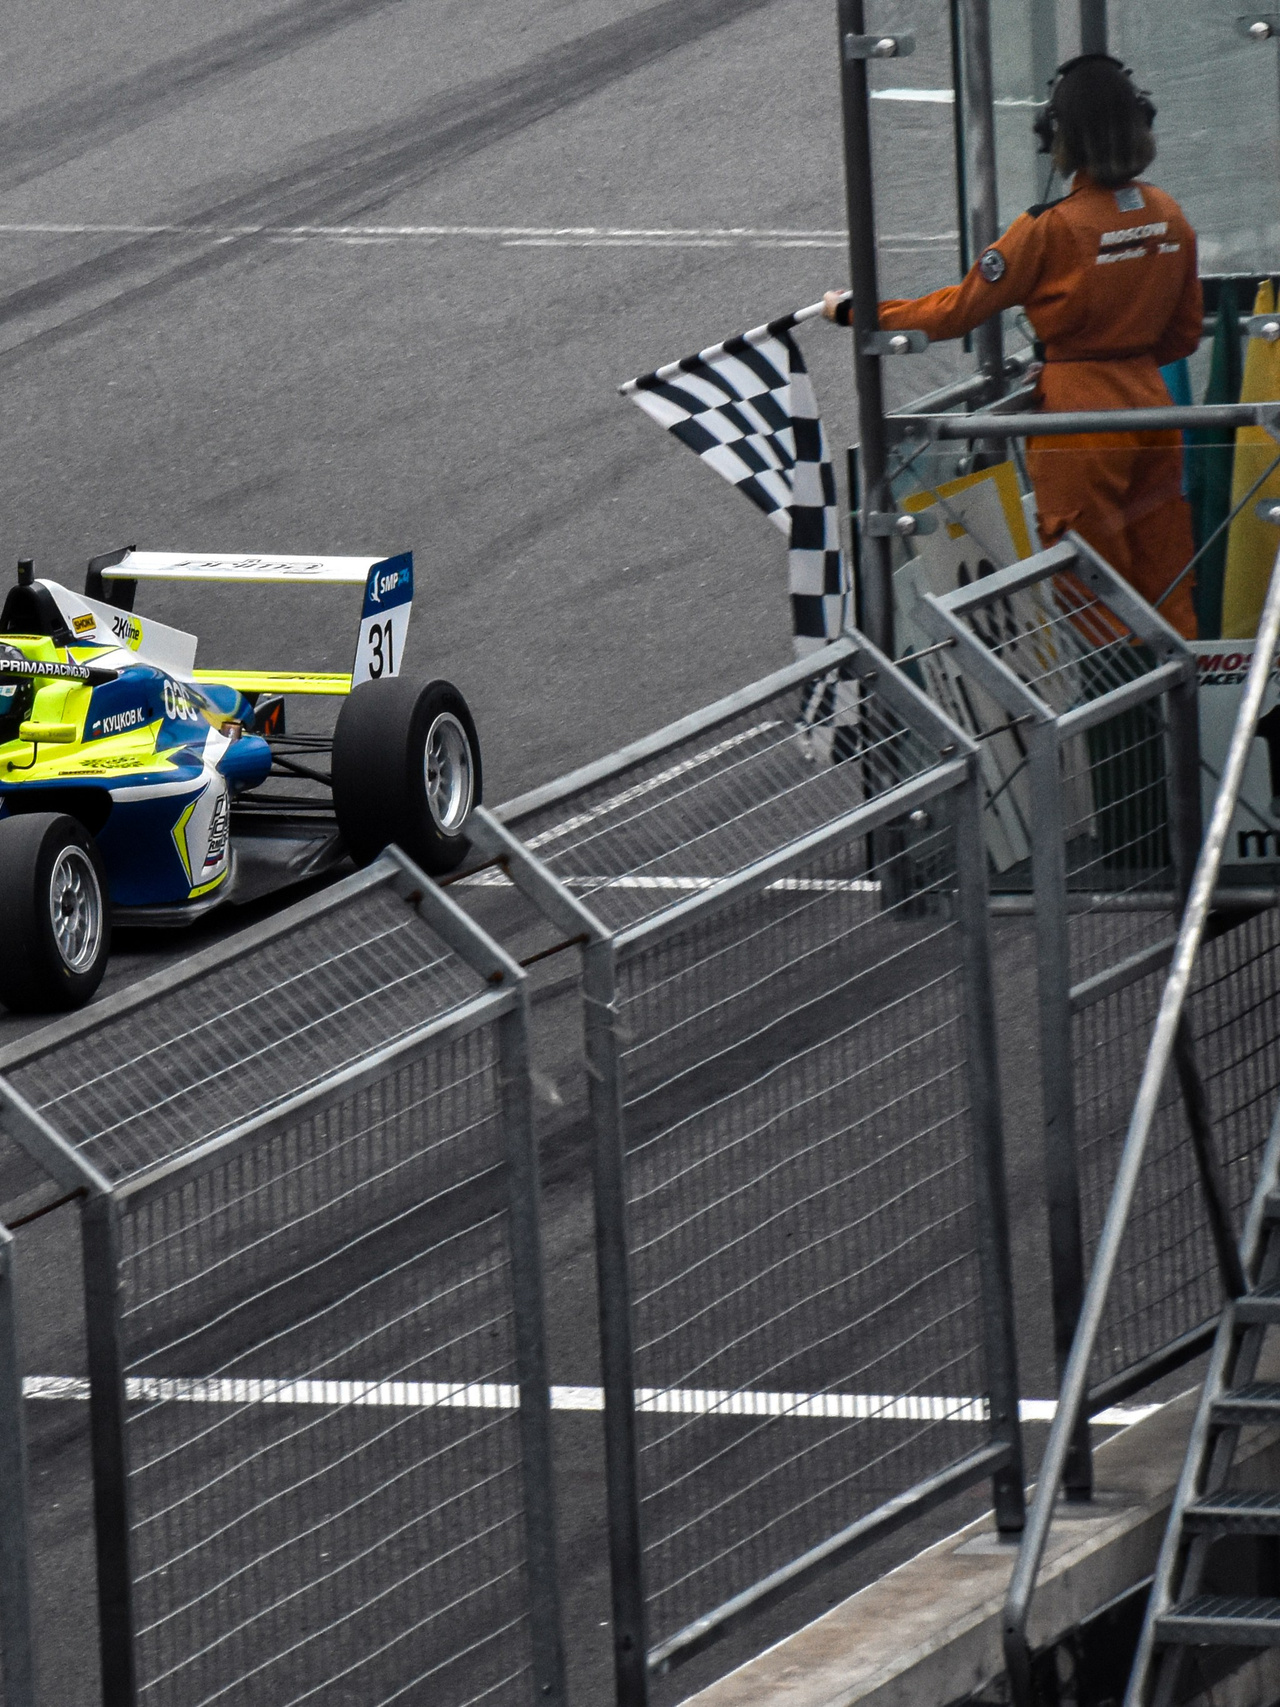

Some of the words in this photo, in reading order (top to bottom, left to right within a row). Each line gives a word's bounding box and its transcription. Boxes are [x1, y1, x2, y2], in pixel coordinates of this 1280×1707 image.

[368, 619, 393, 679] 31
[0, 659, 91, 679] PRIMARACING.RU
[103, 709, 136, 733] КУЦКОВ
[136, 706, 145, 723] К.
